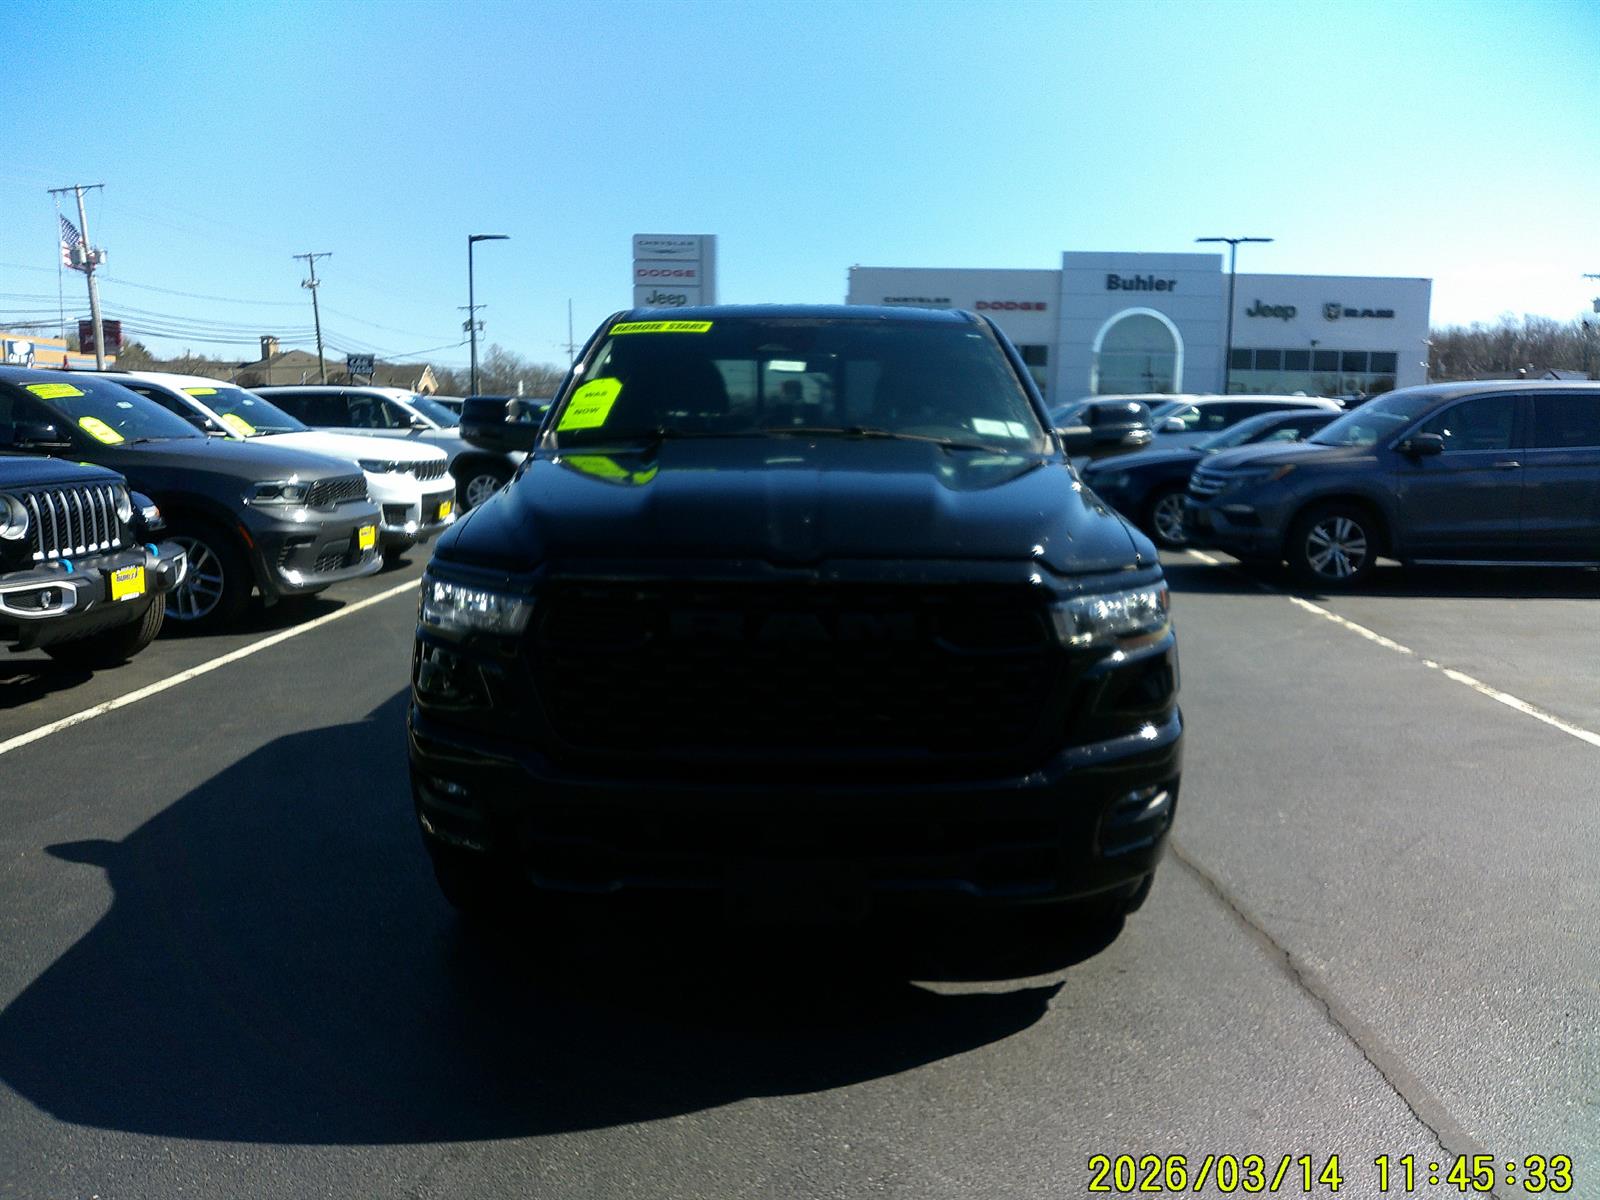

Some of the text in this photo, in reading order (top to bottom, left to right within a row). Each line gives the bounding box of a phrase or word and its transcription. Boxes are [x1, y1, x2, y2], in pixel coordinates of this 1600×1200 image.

[637, 269, 696, 277] DODGE
[1106, 273, 1177, 292] Buhler
[645, 290, 687, 307] Jeep
[976, 301, 1047, 311] DODGE
[1245, 299, 1296, 321] Jeep
[1344, 308, 1395, 319] RAM
[613, 322, 707, 332] REMOTE START
[573, 407, 600, 415] NOW
